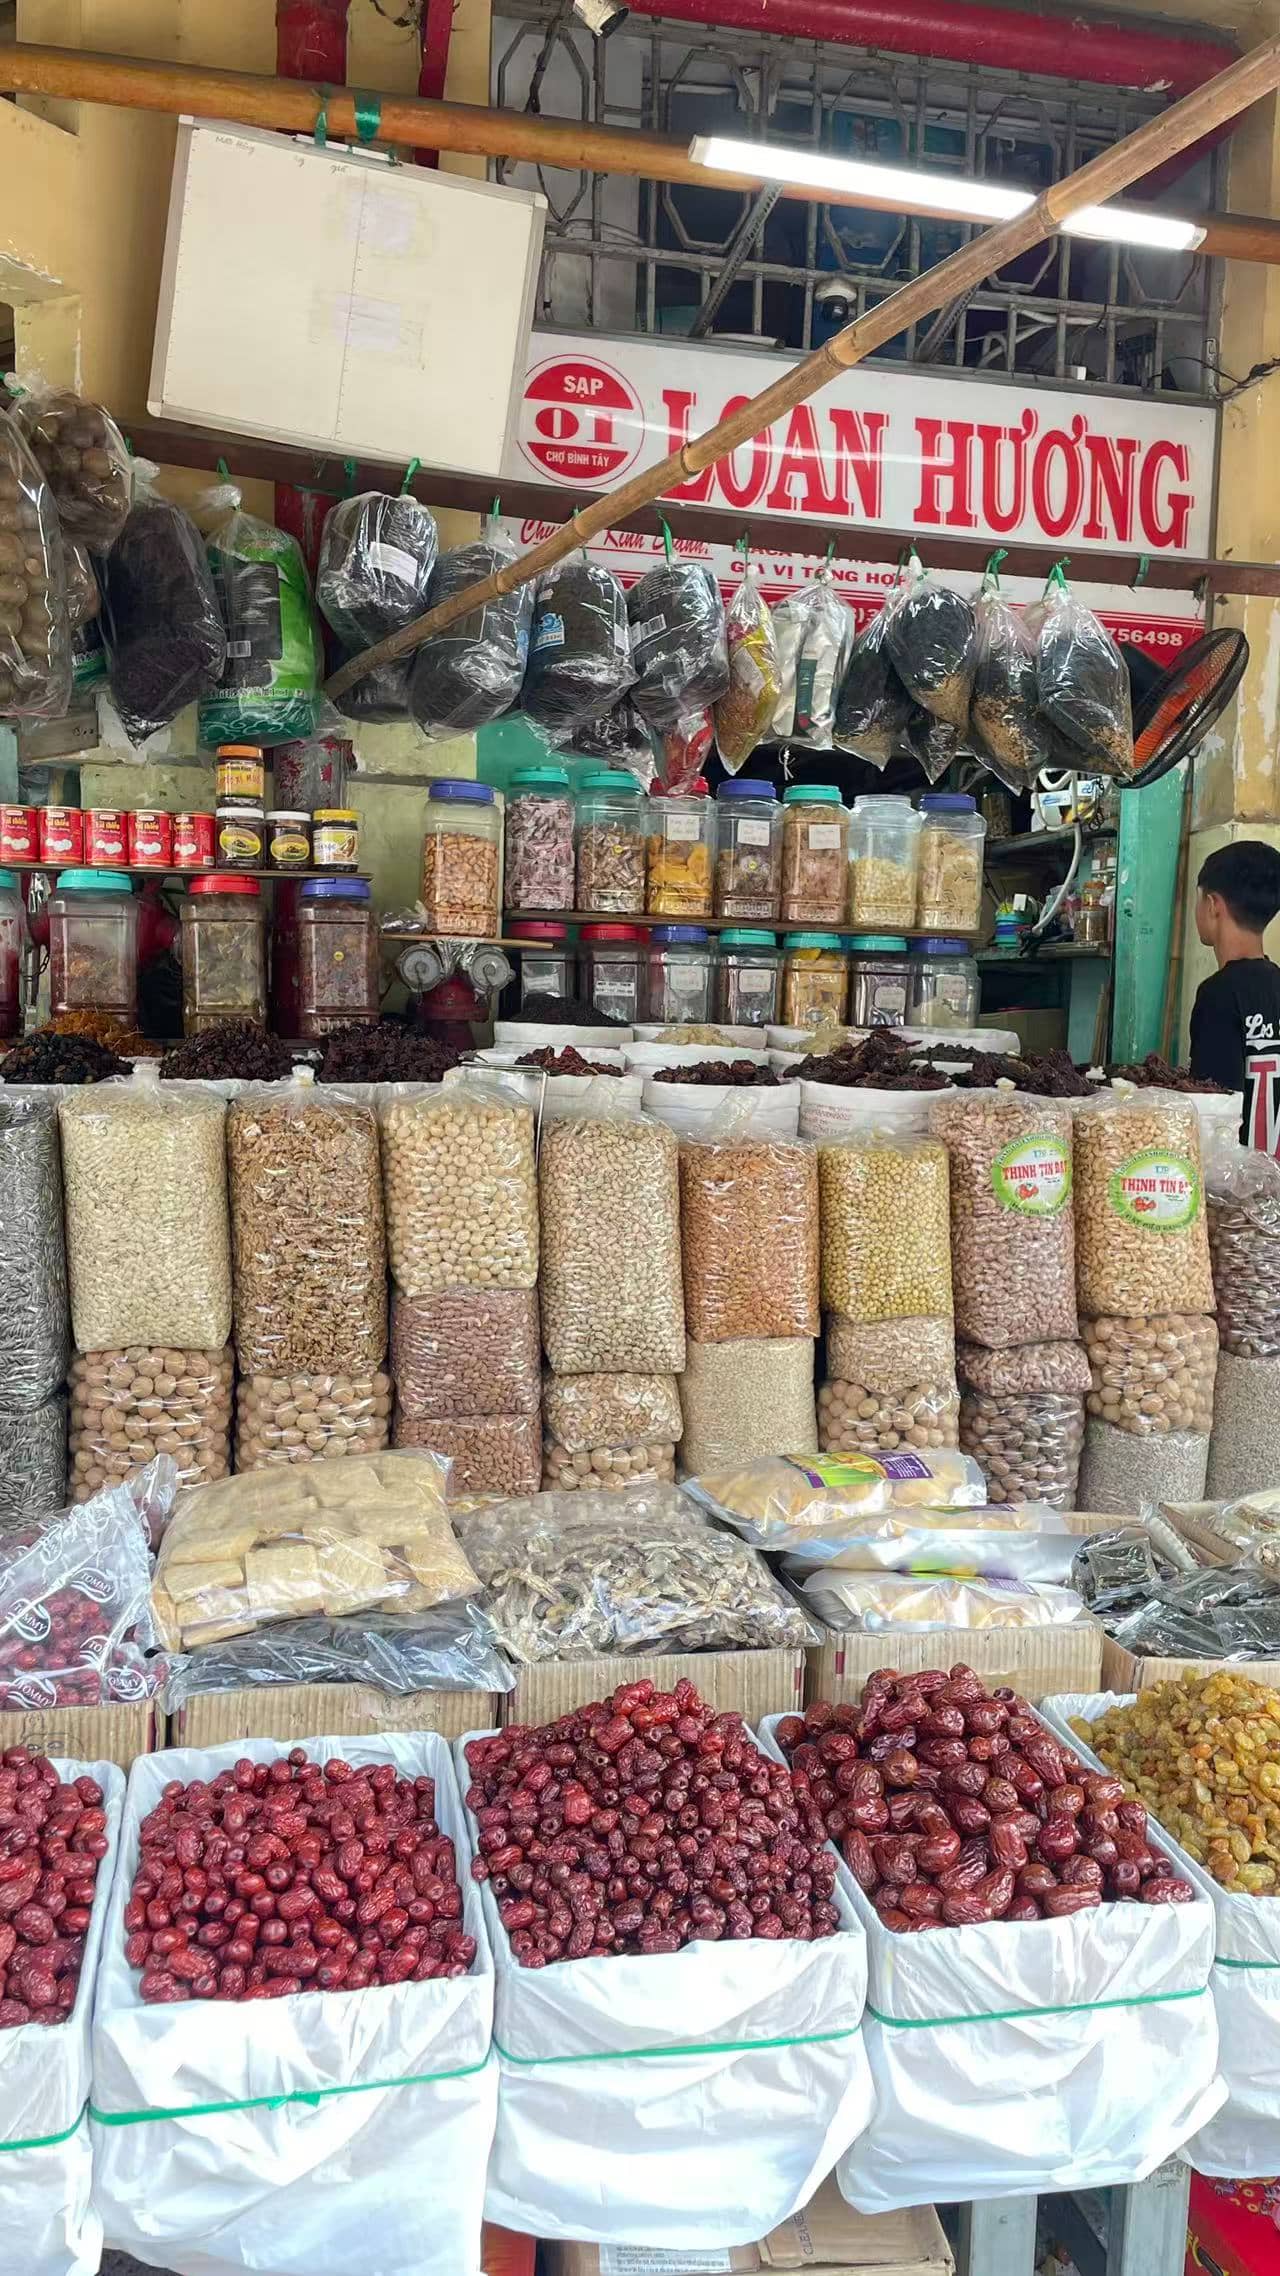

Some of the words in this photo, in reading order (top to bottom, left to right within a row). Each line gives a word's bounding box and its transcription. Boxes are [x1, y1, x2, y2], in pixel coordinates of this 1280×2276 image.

[563, 375, 604, 398] SẠP
[535, 407, 619, 445] 01
[545, 450, 566, 465] CHỢ
[567, 450, 590, 466] BÌNH
[592, 453, 610, 468] TÂY
[658, 389, 890, 519] LOAN
[912, 408, 1196, 549] HƯƠNG
[774, 565, 794, 580] VỊ
[80, 1571, 113, 1594] TOMMY
[16, 1680, 53, 1706] TOMMY
